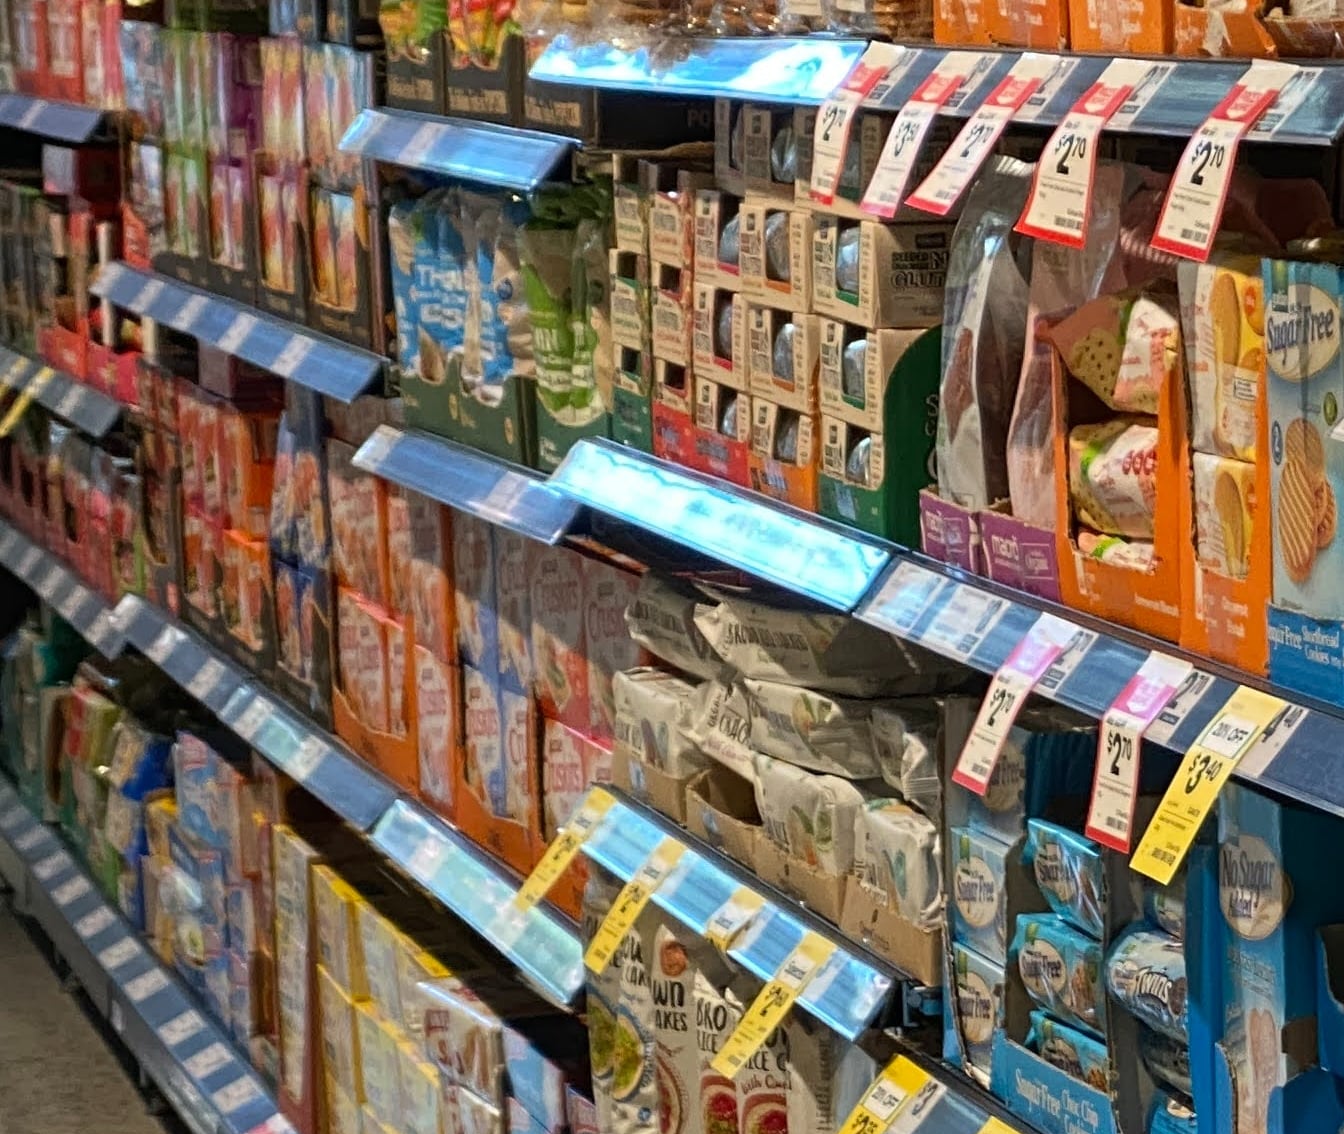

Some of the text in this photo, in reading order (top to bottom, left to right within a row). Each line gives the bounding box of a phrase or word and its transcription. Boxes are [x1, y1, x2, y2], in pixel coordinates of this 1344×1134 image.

[1266, 307, 1334, 367] Sugar Free
[1240, 853, 1275, 900] Sugar
